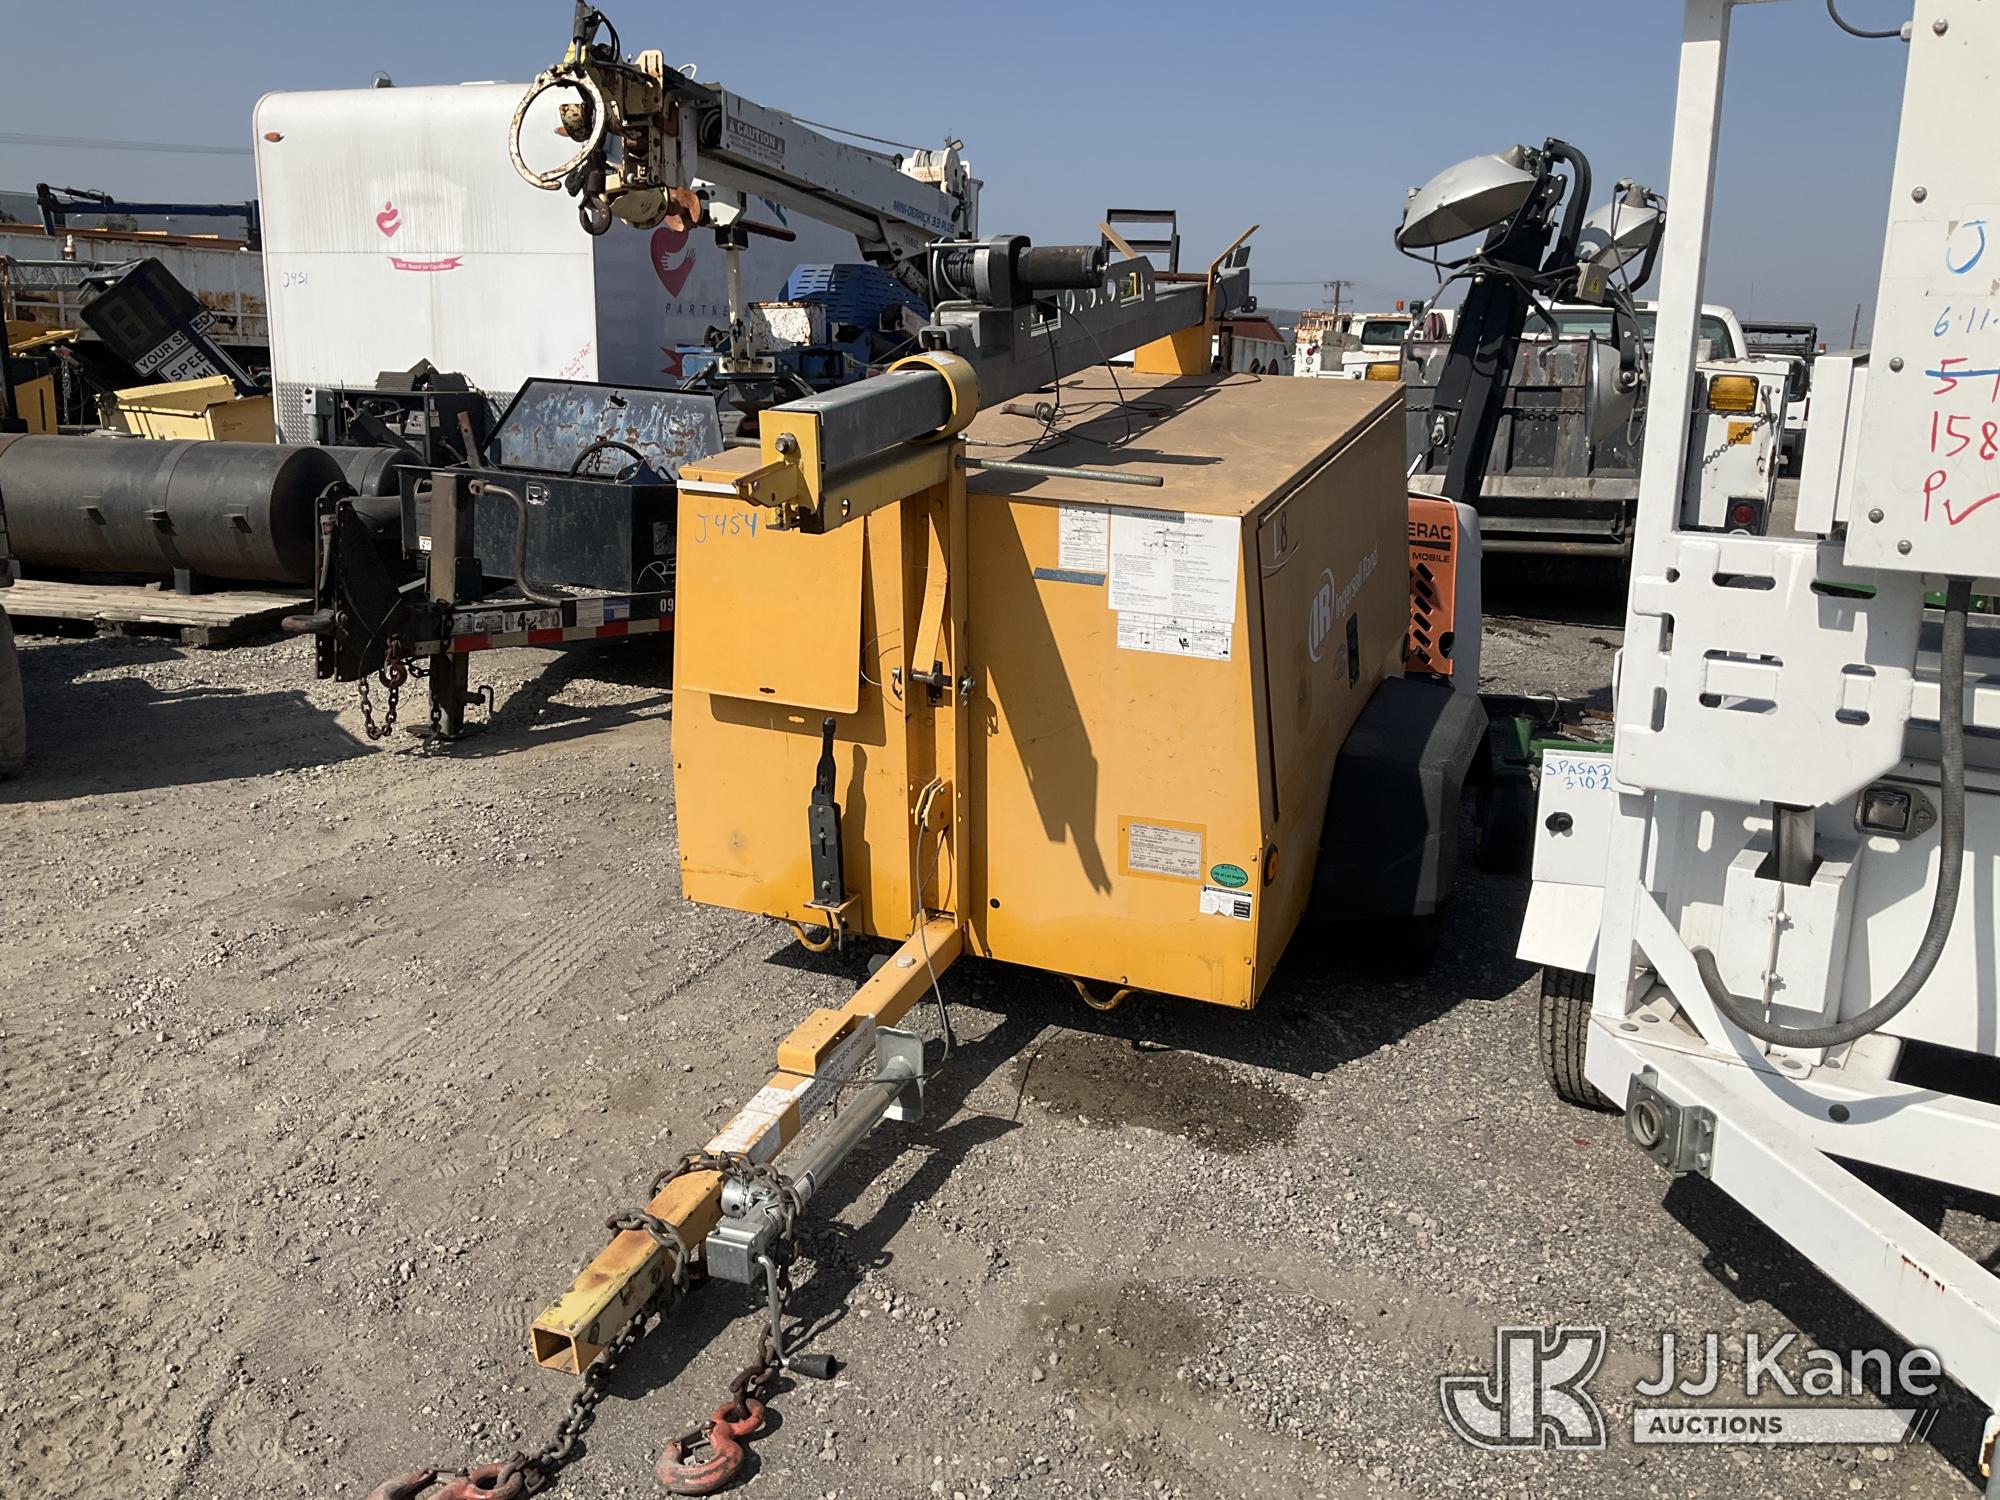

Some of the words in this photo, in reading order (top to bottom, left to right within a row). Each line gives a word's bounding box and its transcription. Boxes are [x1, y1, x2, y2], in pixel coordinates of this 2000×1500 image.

[736, 121, 776, 149] CAUTION
[931, 216, 940, 228] 33
[941, 220, 955, 234] PLUS
[139, 342, 174, 370] YOUR
[1930, 410, 1999, 461] 158
[696, 511, 758, 544] J454
[1149, 513, 1176, 521] OPERATING
[1176, 515, 1214, 524] INSTRUCTIONS
[1412, 551, 1451, 564] MOBILE
